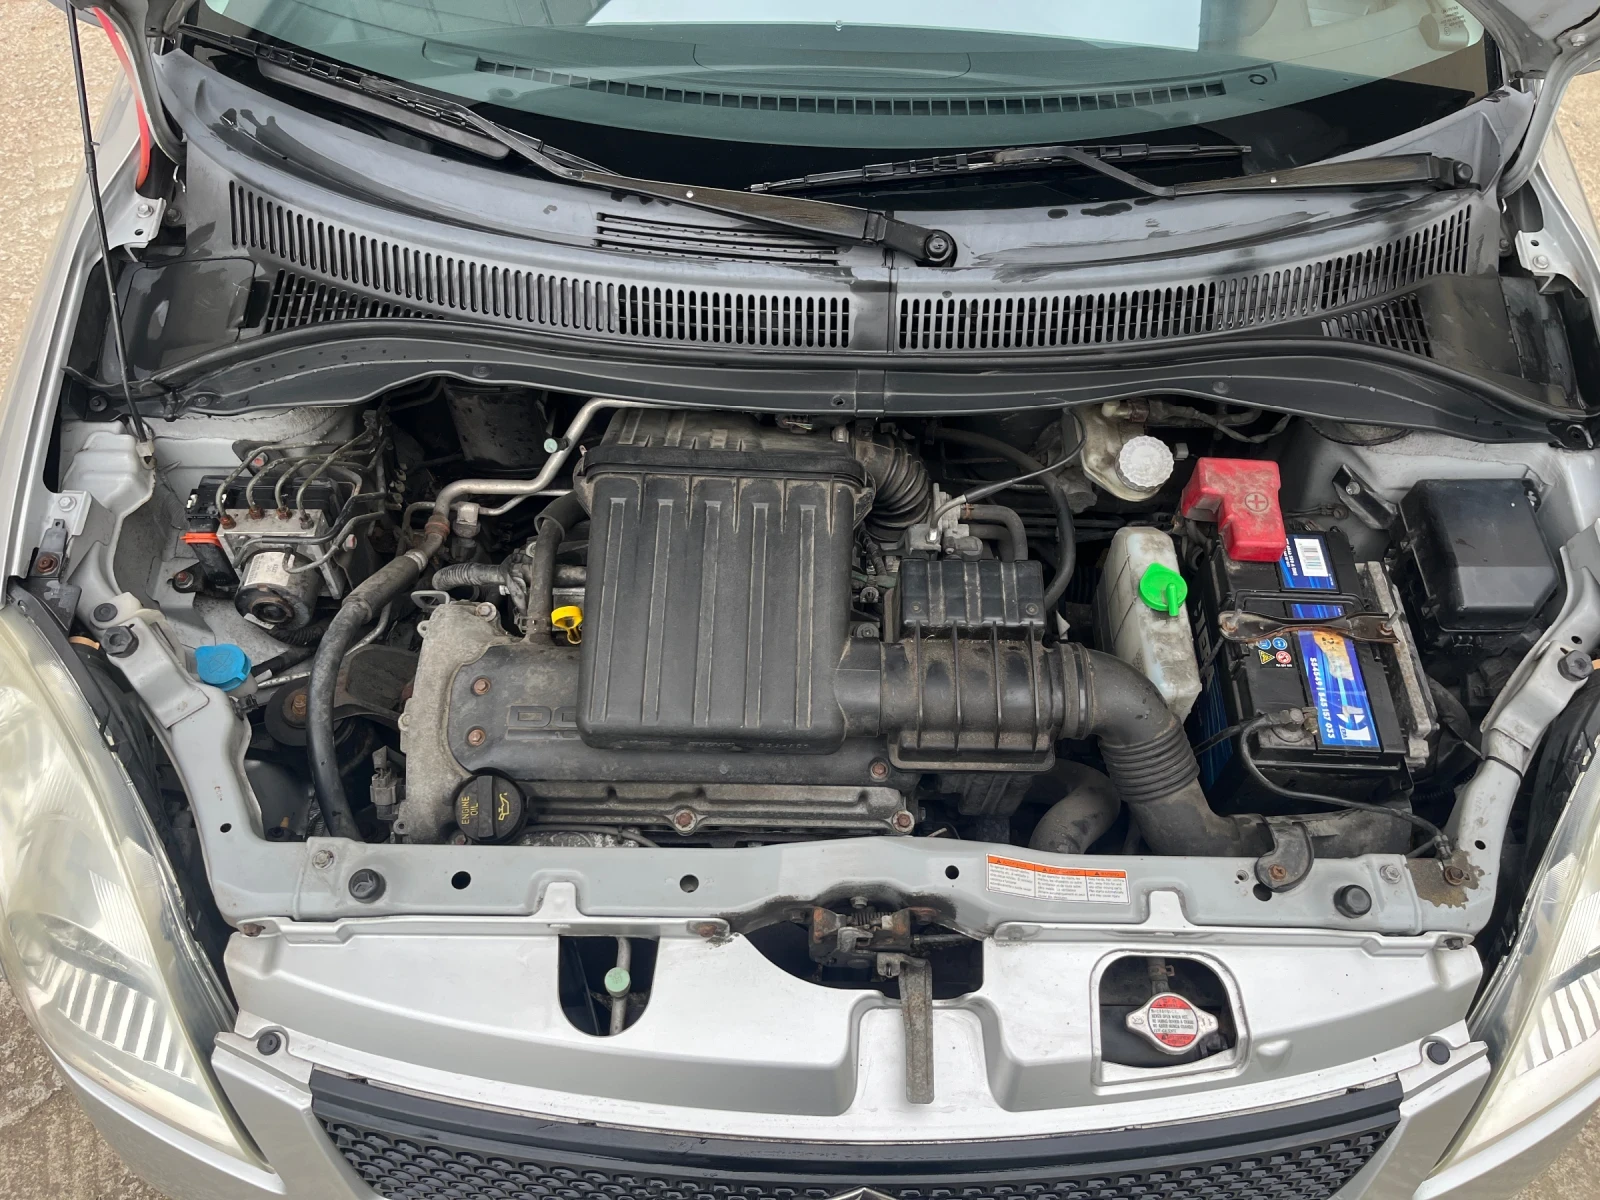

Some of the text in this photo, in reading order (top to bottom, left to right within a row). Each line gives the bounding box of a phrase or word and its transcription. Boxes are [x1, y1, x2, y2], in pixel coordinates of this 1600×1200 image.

[1318, 692, 1328, 709] 545
[1322, 709, 1331, 722] 157
[1325, 723, 1335, 739] 033
[462, 796, 470, 825] ENGINE
[470, 802, 478, 816] OIL
